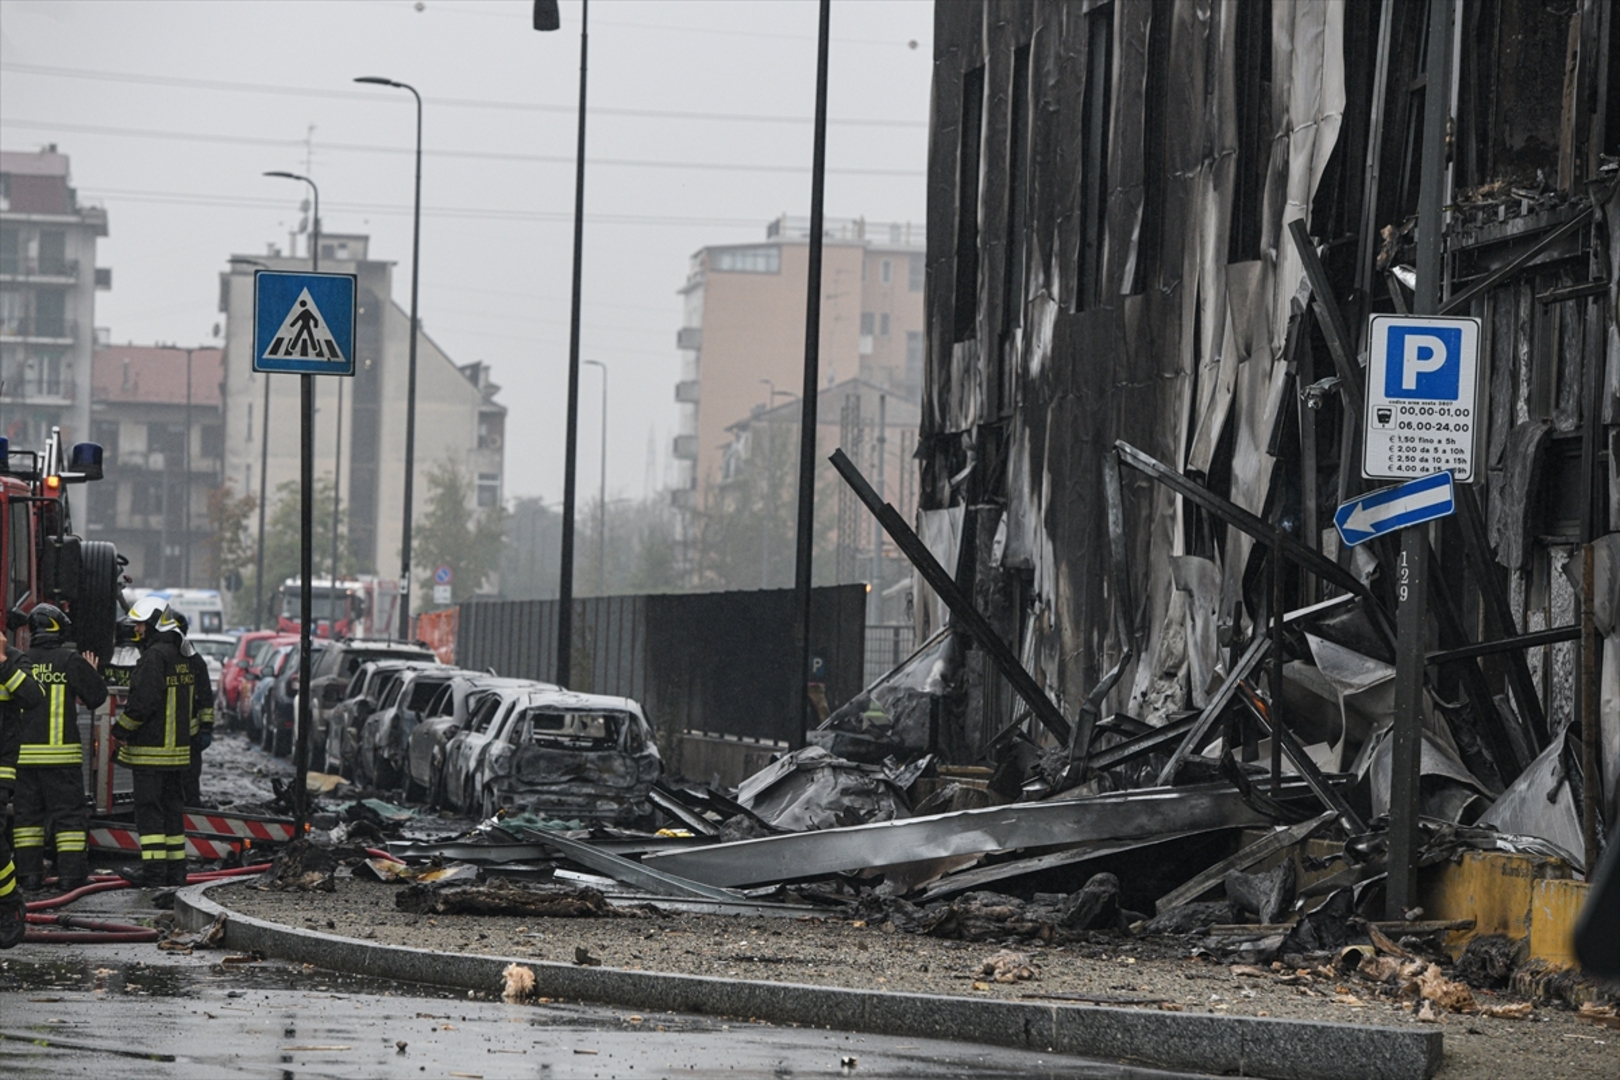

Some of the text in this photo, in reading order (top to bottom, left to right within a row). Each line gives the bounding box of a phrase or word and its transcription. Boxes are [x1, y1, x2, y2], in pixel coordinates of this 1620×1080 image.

[1402, 334, 1447, 390] P
[1446, 437, 1456, 445] 5h
[1420, 446, 1430, 454] da
[1399, 551, 1409, 601] 129
[812, 657, 823, 673] P
